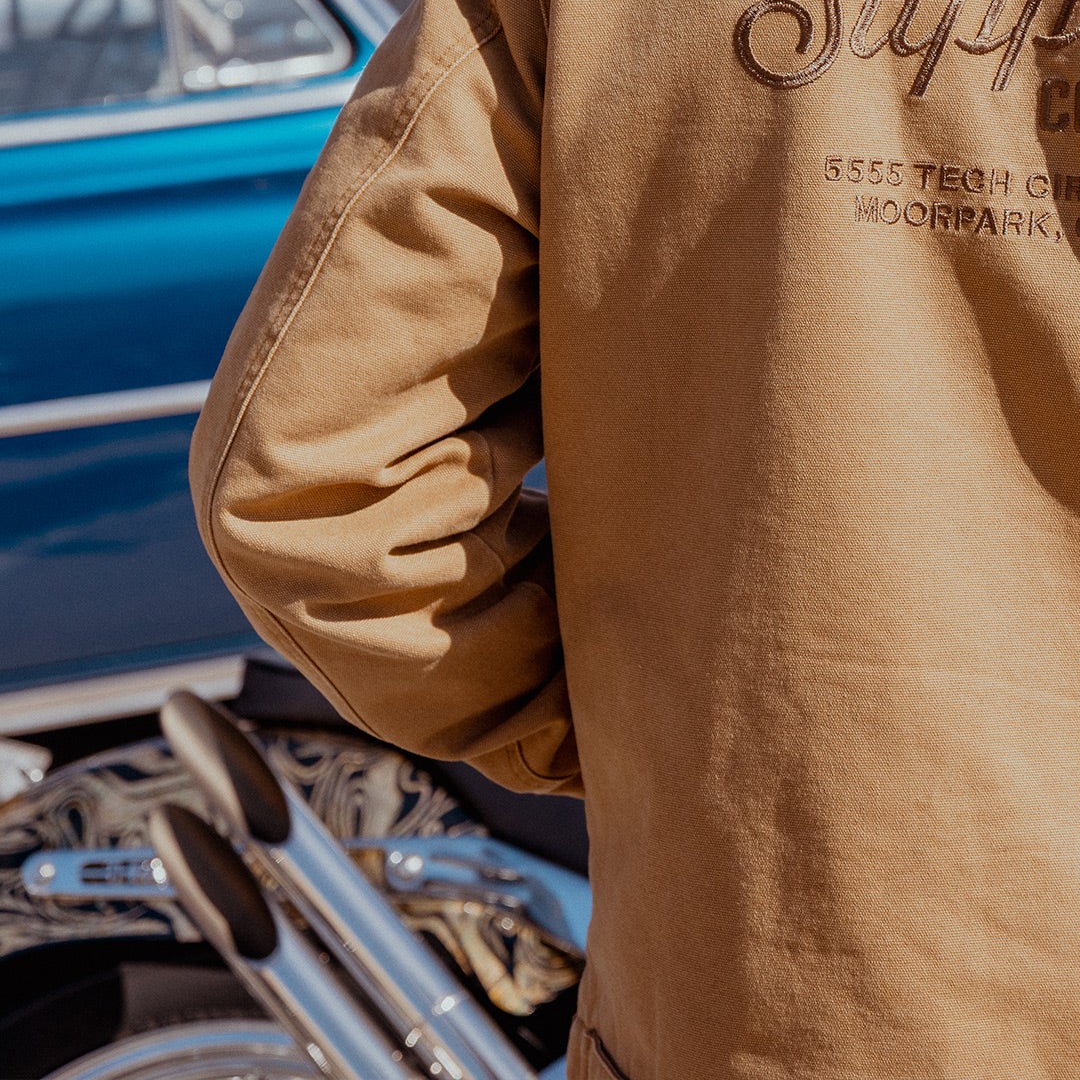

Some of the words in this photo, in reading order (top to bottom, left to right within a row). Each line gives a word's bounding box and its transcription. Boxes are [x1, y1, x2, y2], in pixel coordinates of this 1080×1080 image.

[824, 155, 904, 186] 5555
[914, 162, 1012, 197] TECH
[854, 195, 1064, 243] MOORPARK,
